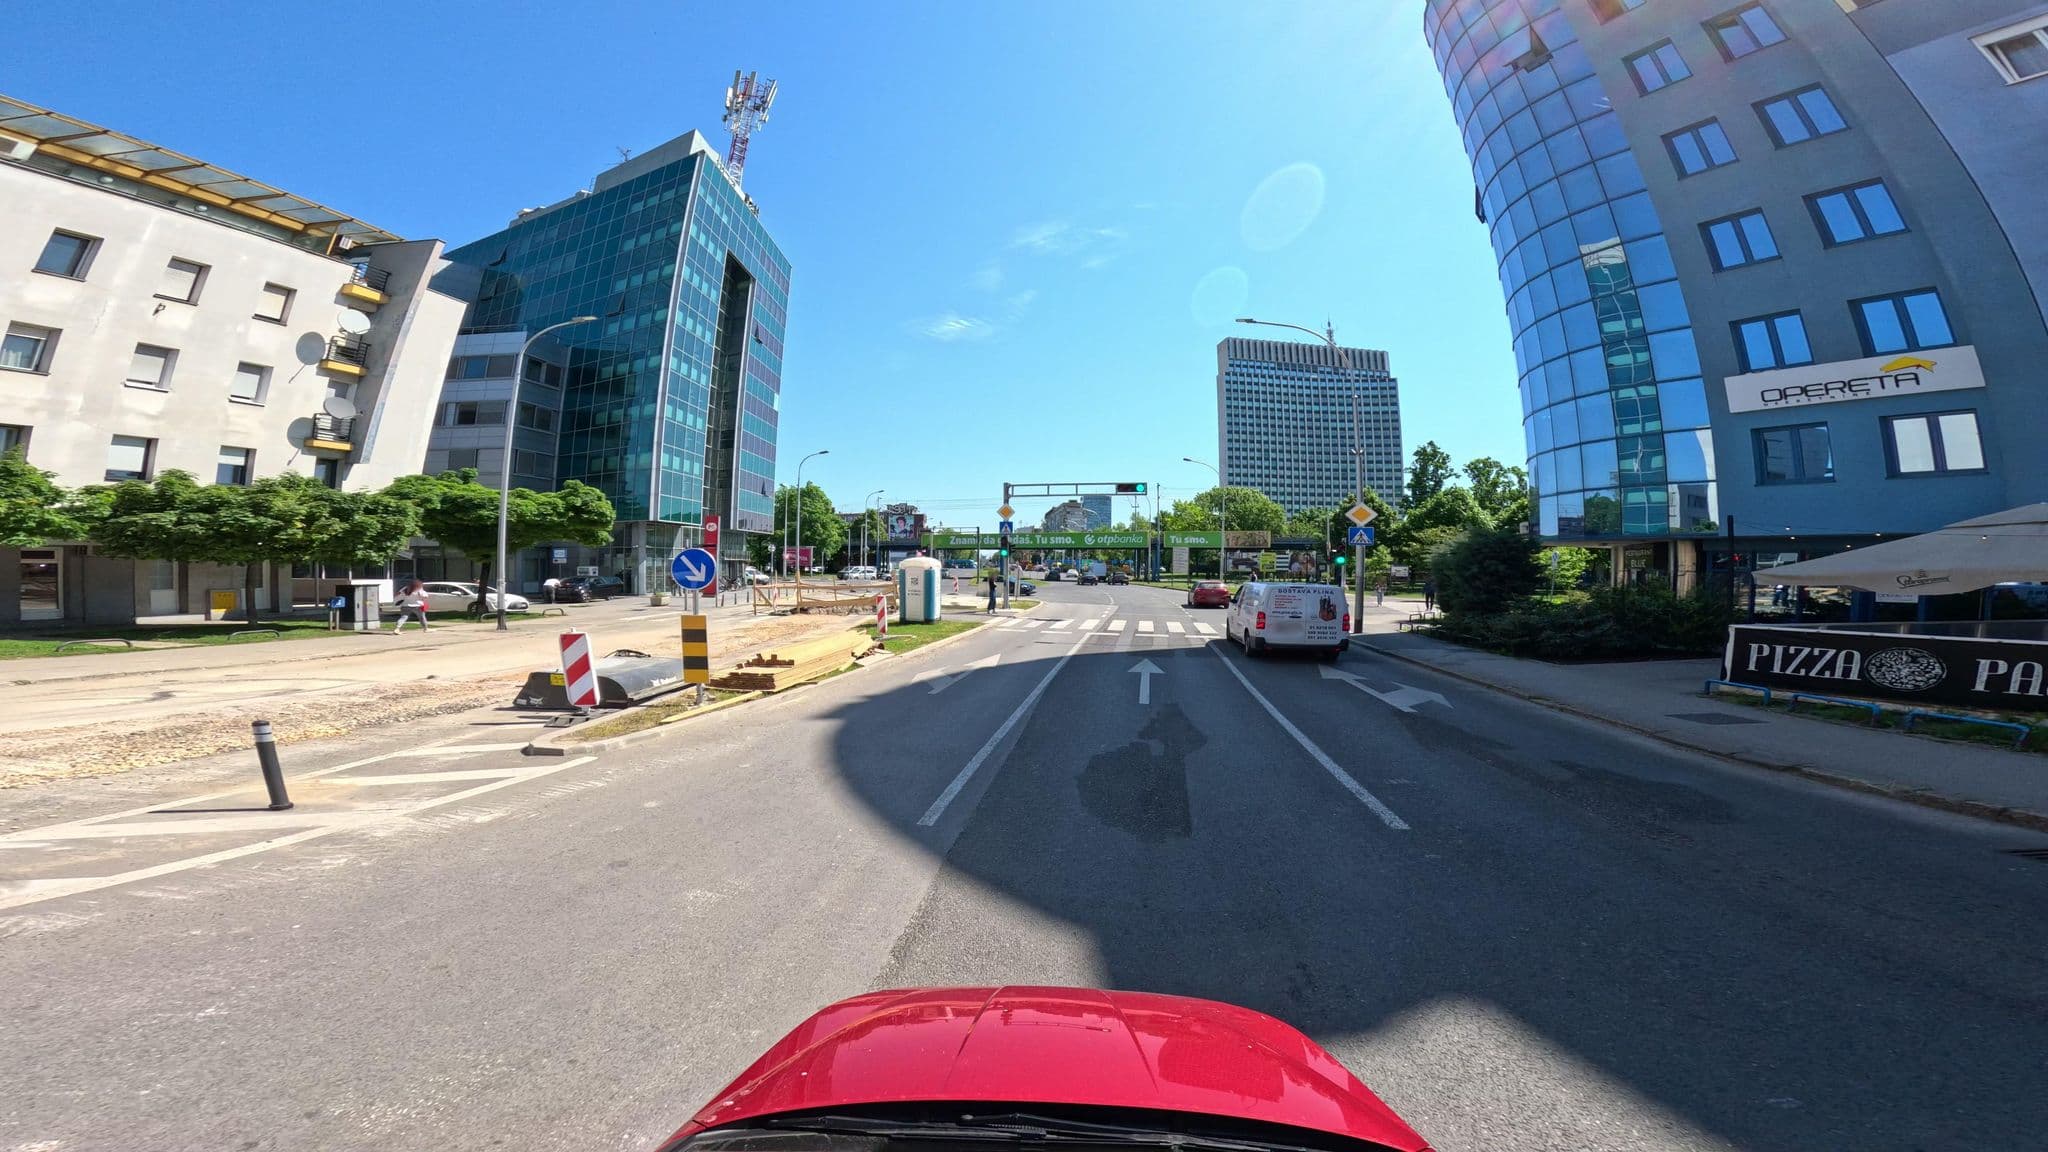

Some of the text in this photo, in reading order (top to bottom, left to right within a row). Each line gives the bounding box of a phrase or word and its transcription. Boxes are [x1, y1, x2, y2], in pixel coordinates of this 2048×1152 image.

[1760, 372, 1921, 403] OPERETA
[983, 535, 996, 545] da
[1035, 534, 1048, 545] Tu
[1050, 536, 1076, 545] smo.
[1169, 535, 1209, 544] Tu smo.
[1746, 643, 2048, 697] PIZZA PA
